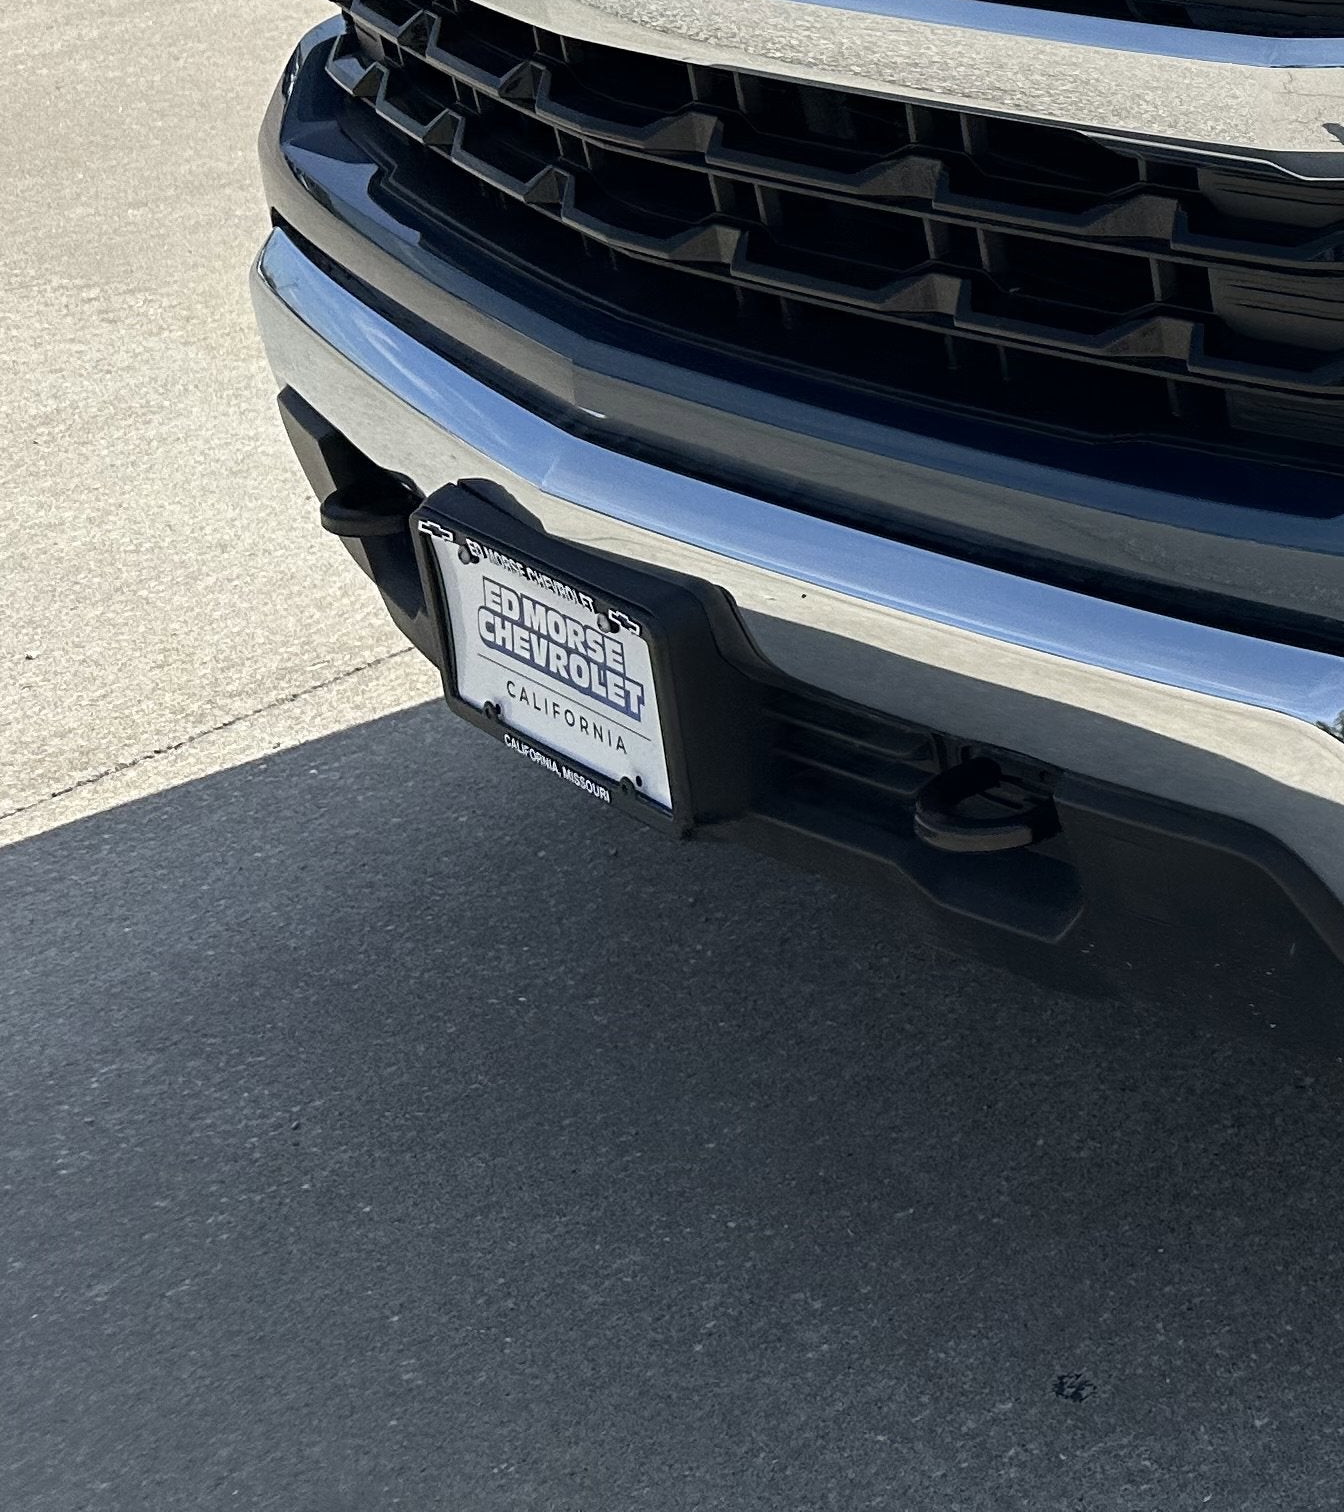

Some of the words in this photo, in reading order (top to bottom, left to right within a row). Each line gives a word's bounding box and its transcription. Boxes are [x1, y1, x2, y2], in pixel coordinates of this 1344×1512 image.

[466, 538, 485, 558] ED
[526, 567, 596, 614] CHEVROLET
[478, 606, 643, 721] CHEVROLET
[483, 576, 521, 622] ED
[520, 593, 626, 675] MORSE
[507, 680, 627, 754] CALIFORNIA
[504, 734, 562, 778] CALIFORNIA,
[561, 766, 611, 803] MISSOURI
